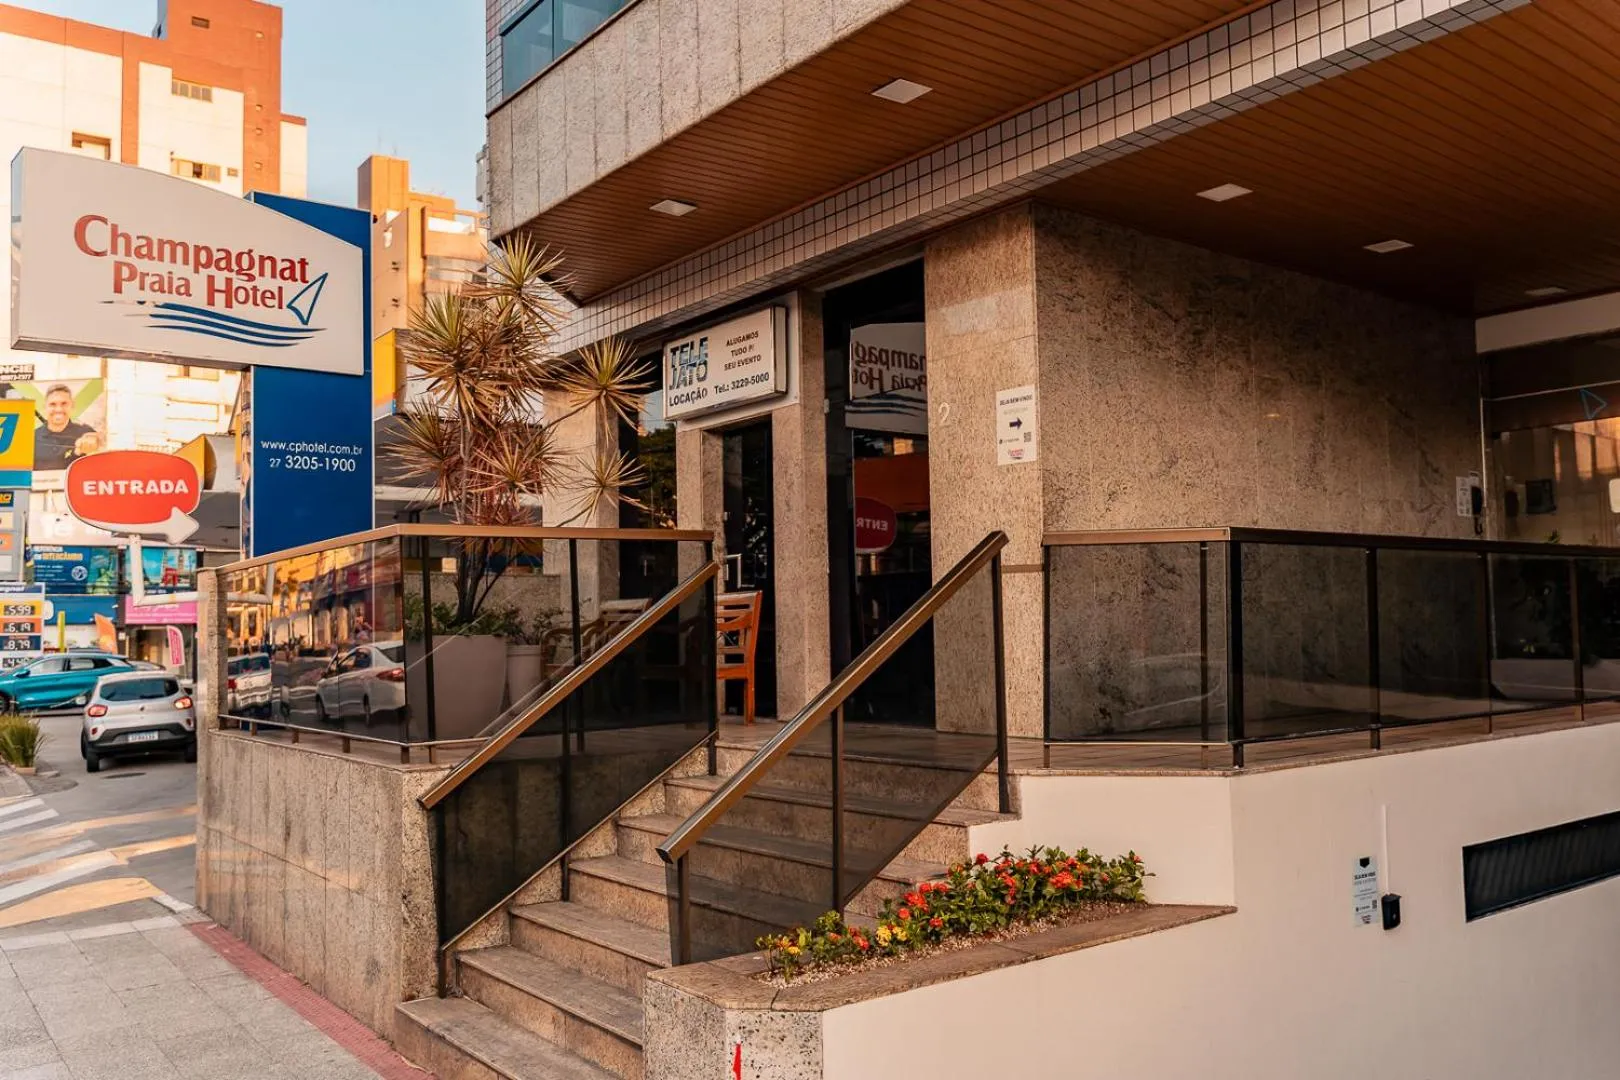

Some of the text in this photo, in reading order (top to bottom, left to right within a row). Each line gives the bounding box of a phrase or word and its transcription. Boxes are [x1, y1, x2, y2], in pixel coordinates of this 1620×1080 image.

[74, 214, 309, 283] Champagnat
[113, 260, 283, 310] Praia Hotel
[726, 330, 759, 347] ALUGAMOS
[670, 336, 708, 368] TELE
[730, 346, 747, 357] TUDO
[724, 354, 761, 371] SEU EVENTO
[669, 359, 708, 391] JATO
[731, 372, 769, 390] 3229-5000
[669, 387, 708, 407] LOCAÇÃO
[260, 440, 363, 456] www.cphotel.com.br
[269, 455, 356, 472] 27 3205-1900
[82, 479, 189, 496] ENTRADA
